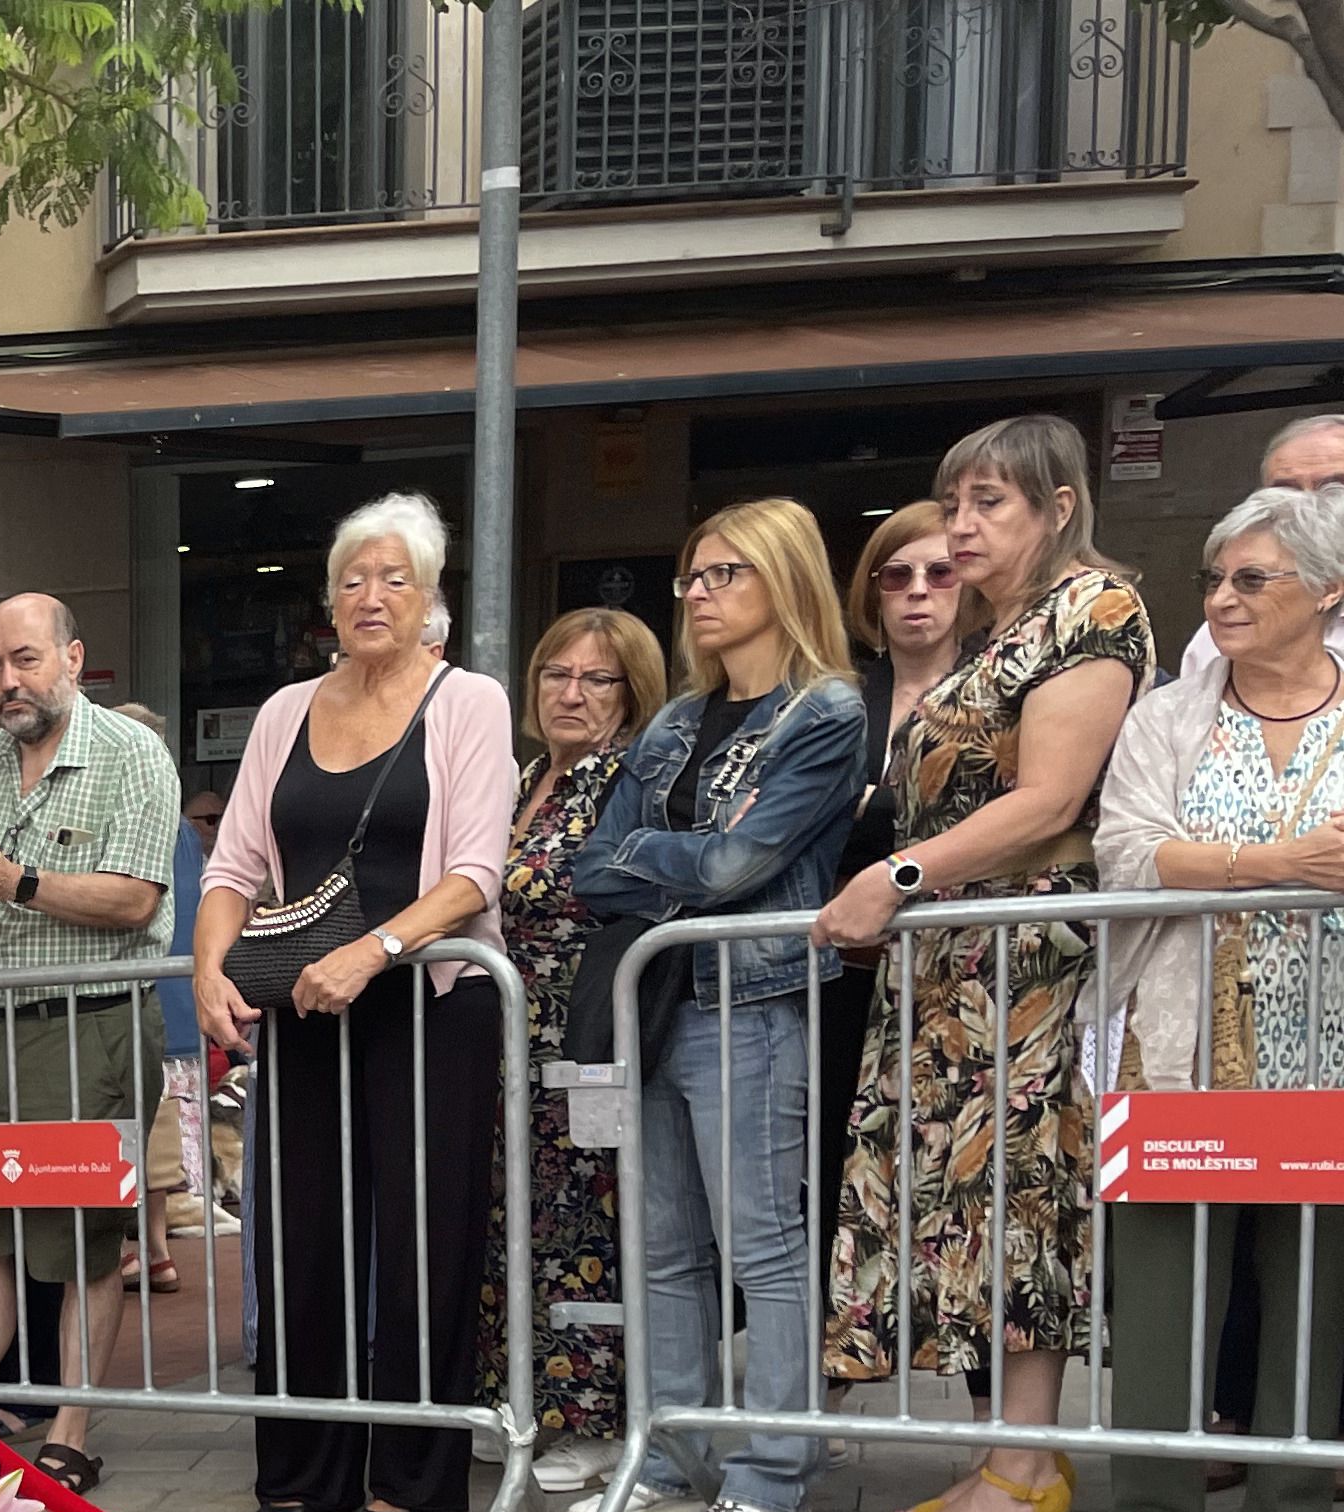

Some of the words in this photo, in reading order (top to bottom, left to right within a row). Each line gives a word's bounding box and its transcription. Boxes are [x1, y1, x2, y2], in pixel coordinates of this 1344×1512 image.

[1143, 1140, 1225, 1153] DISCULPEU
[28, 1162, 77, 1176] Ajuntament
[78, 1162, 90, 1173] de
[1143, 1157, 1170, 1171] LES
[1172, 1155, 1258, 1171] MOLÈSTIES!
